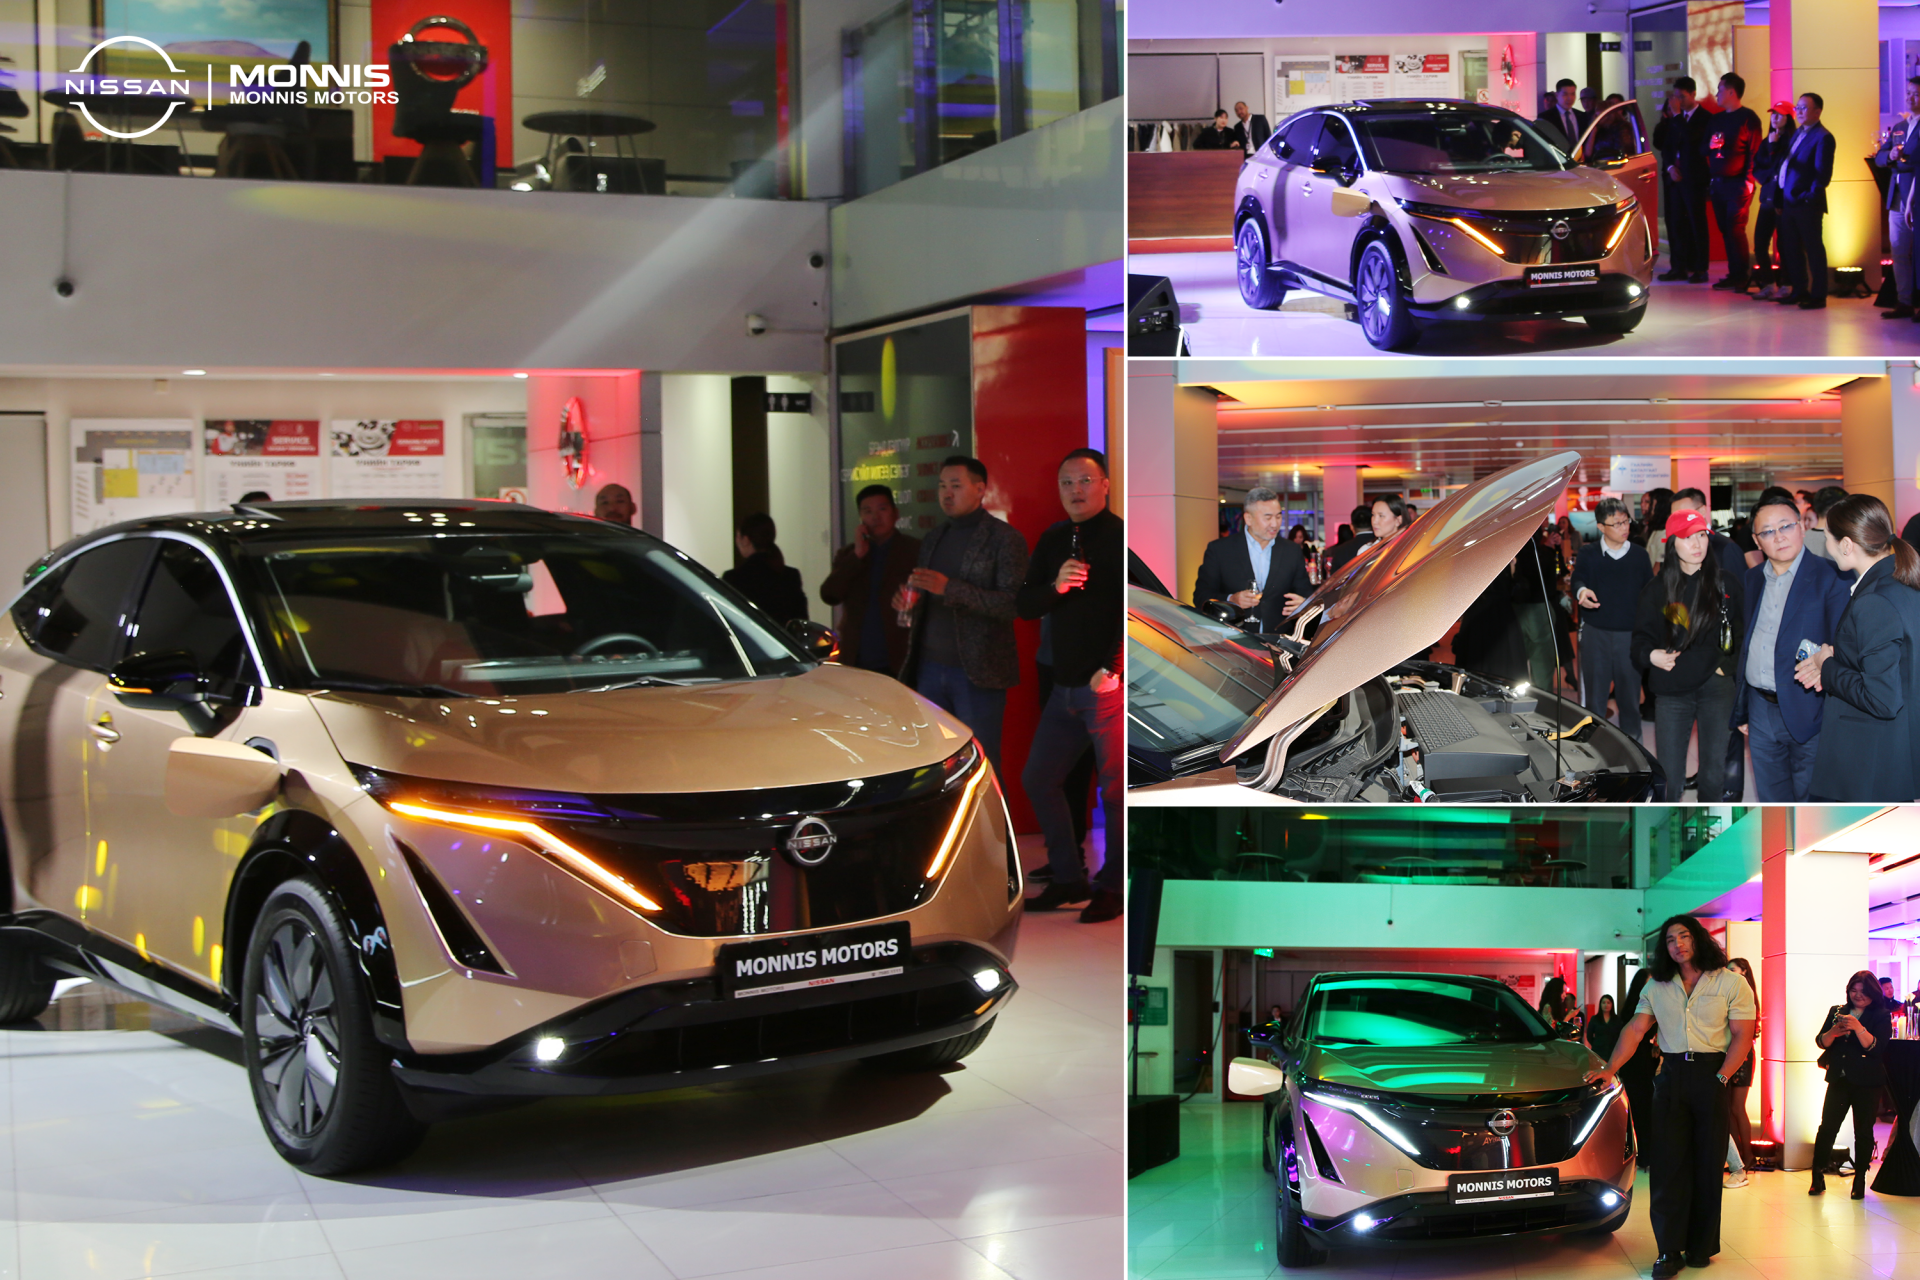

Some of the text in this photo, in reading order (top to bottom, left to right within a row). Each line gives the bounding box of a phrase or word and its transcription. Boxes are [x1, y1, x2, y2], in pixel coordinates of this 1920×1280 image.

[1530, 269, 1596, 280] MONNIS MOTORS
[787, 835, 837, 849] NISSAN
[736, 938, 899, 978] MONNIS MOTORS
[808, 977, 835, 986] NISSAN
[1456, 1176, 1552, 1193] MONNIS MOTORS
